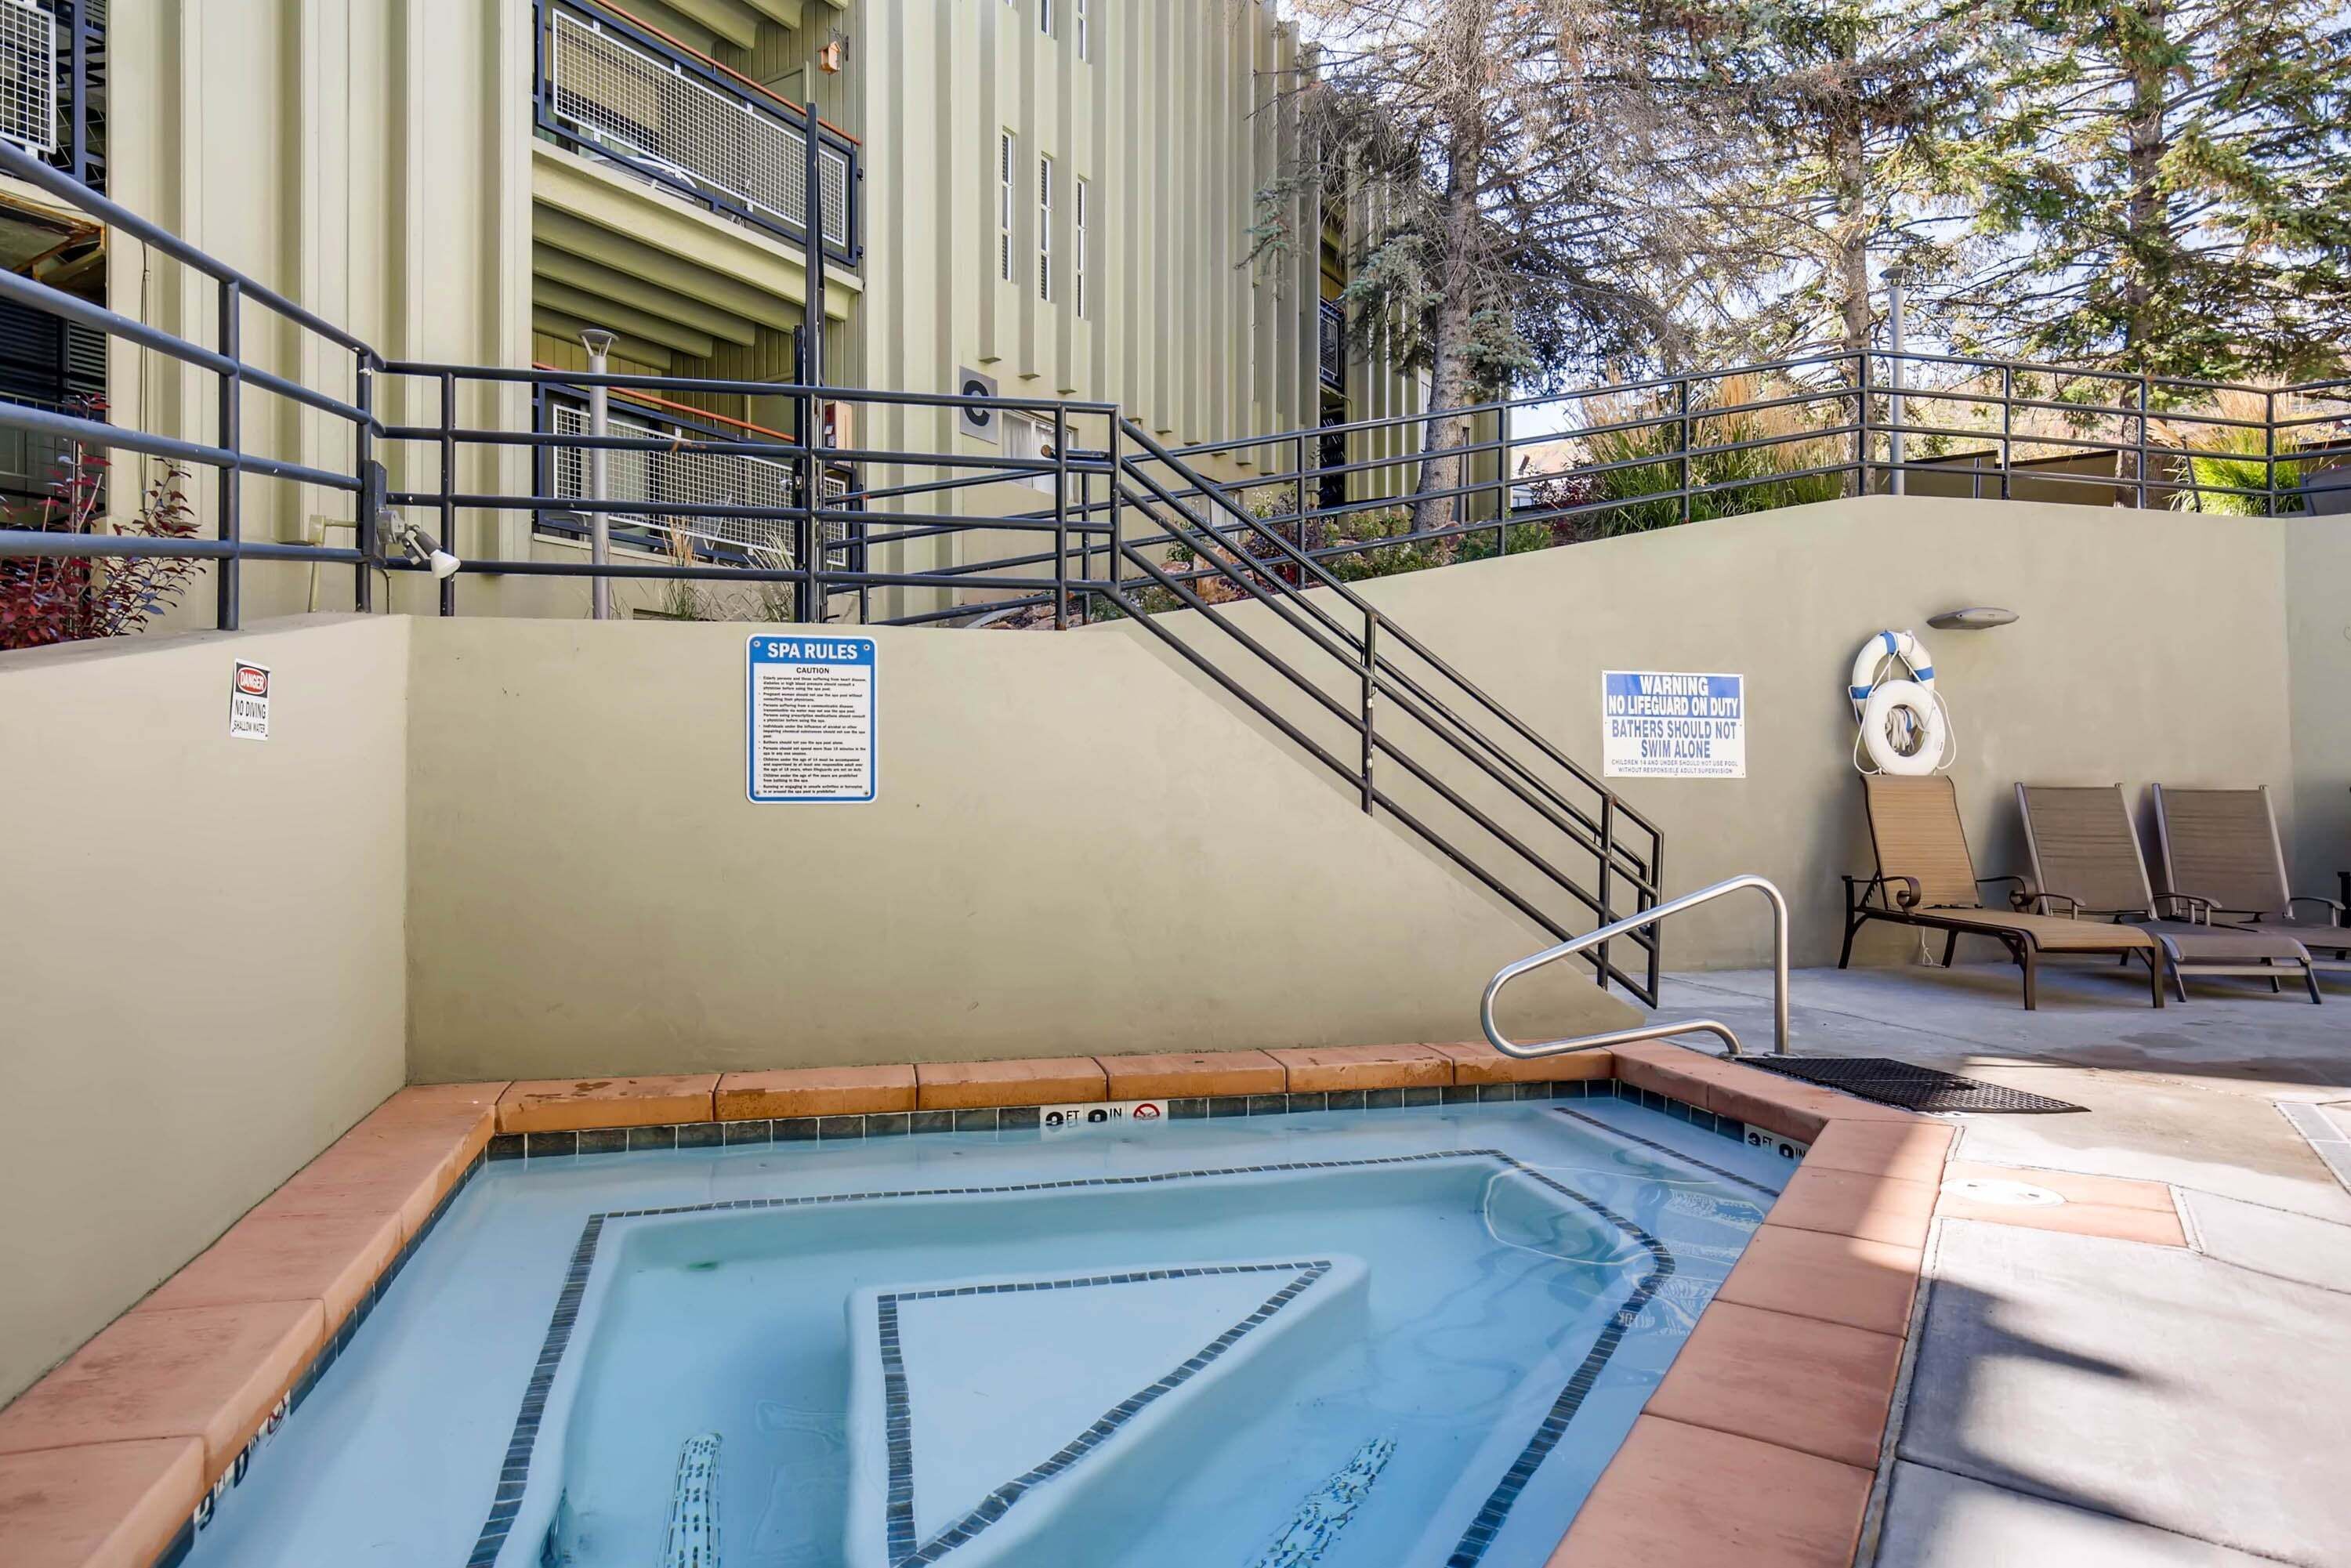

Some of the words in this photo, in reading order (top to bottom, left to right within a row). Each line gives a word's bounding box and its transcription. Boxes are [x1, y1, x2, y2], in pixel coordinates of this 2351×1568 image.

[963, 380, 990, 426] C
[767, 643, 801, 658] SPA
[805, 643, 858, 659] RULES
[240, 672, 264, 690] DANGER
[1639, 675, 1709, 696] WARNING
[235, 699, 244, 716] NO
[245, 701, 266, 719] DIVING
[1608, 695, 1625, 715] NO
[1628, 696, 1689, 715] LIFEGUARD
[1692, 697, 1707, 716] ON
[1711, 697, 1739, 716] DUTY
[1612, 719, 1664, 738] BATHERS
[1668, 720, 1712, 739] SHOULD
[1715, 721, 1737, 739] NOT
[1642, 740, 1671, 758] SWIM
[1675, 741, 1711, 759] ALONE
[1067, 1110, 1079, 1120] FT
[1110, 1108, 1121, 1117] IN
[1763, 1136, 1773, 1147] FT
